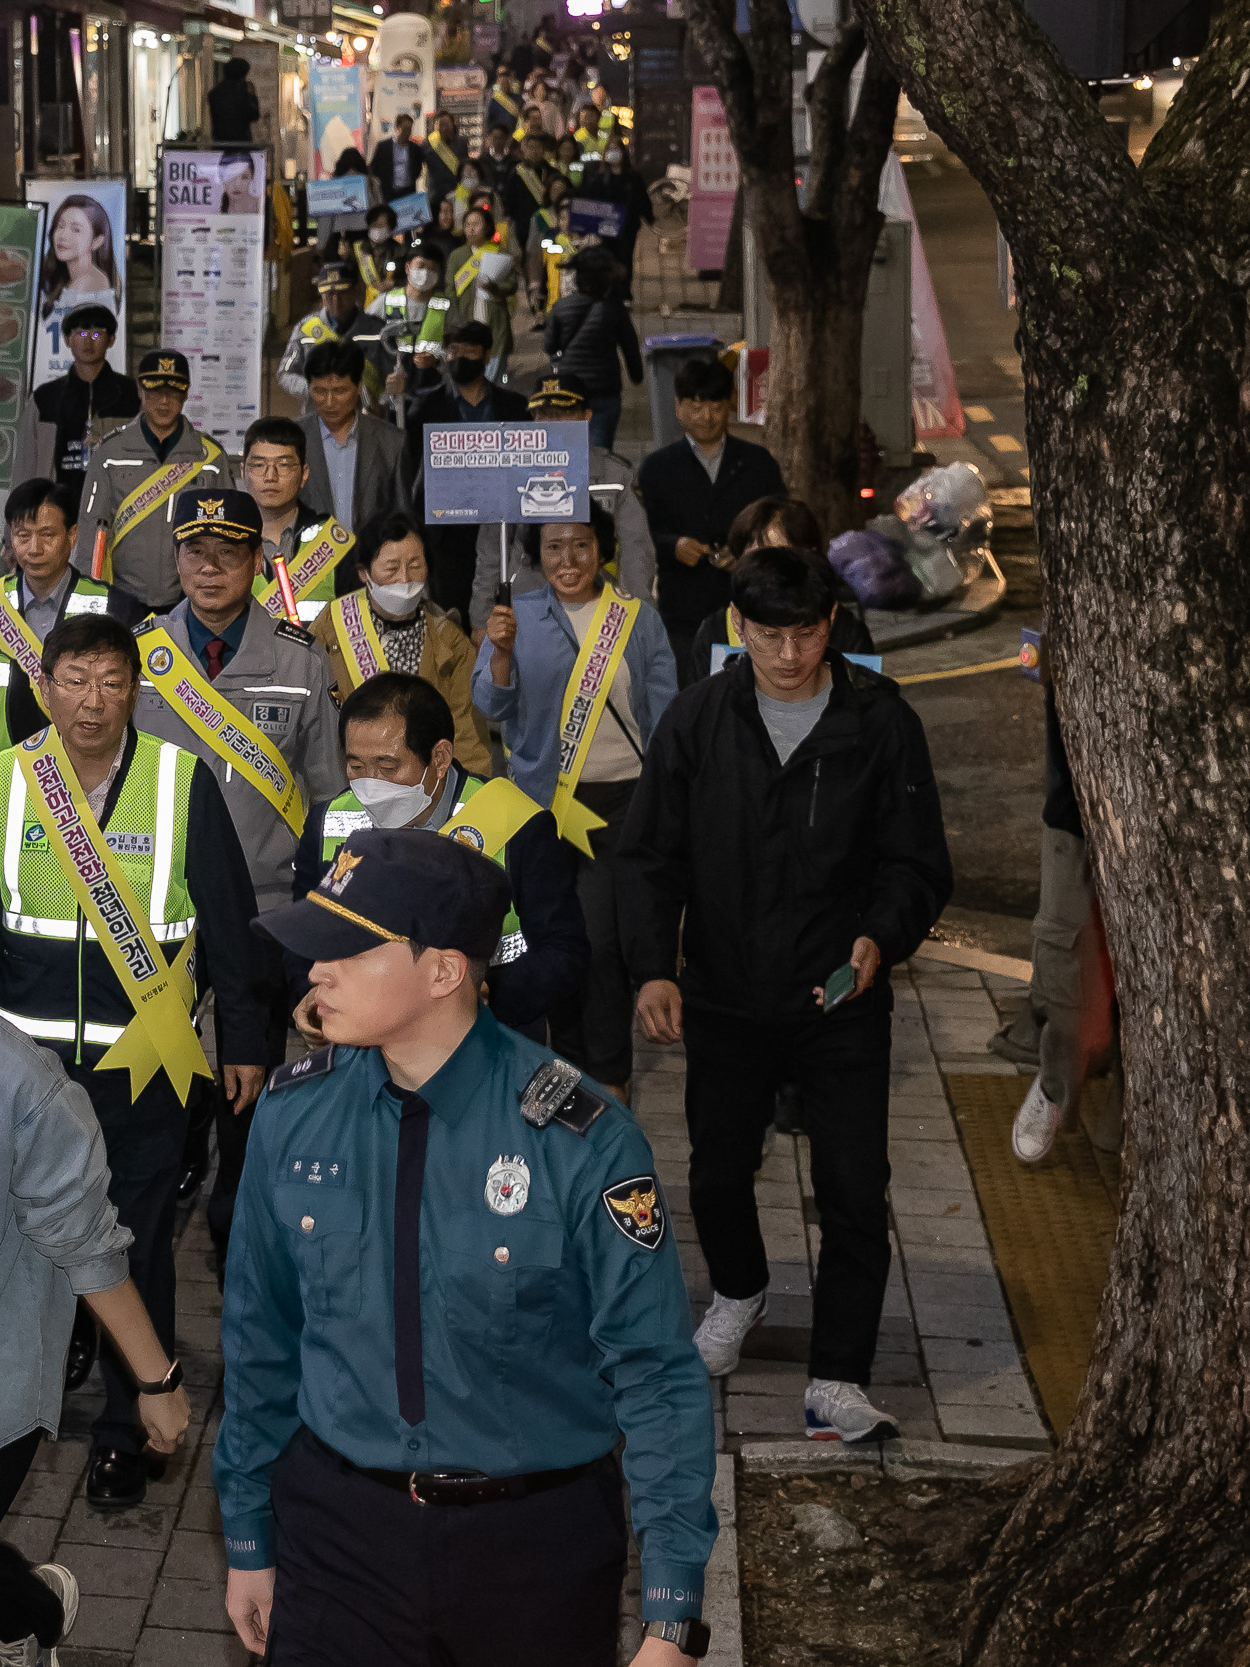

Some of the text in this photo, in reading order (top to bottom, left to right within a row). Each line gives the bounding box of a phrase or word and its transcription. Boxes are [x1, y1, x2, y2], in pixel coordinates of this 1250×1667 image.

[169, 162, 197, 181] BIG
[169, 185, 212, 205] SALE
[430, 429, 547, 452] 건대맛의 거리!
[292, 541, 334, 587] 안전하고
[578, 652, 610, 698] 건전한
[173, 678, 225, 731] 범죄없는
[258, 707, 287, 721] 경찰
[257, 723, 287, 731] POLICE
[563, 696, 594, 744] 청년의
[32, 753, 158, 982] 안전하고 건전한 청년의 거리
[140, 981, 168, 1002] 광진경찰서
[636, 1223, 659, 1237] POLICE
